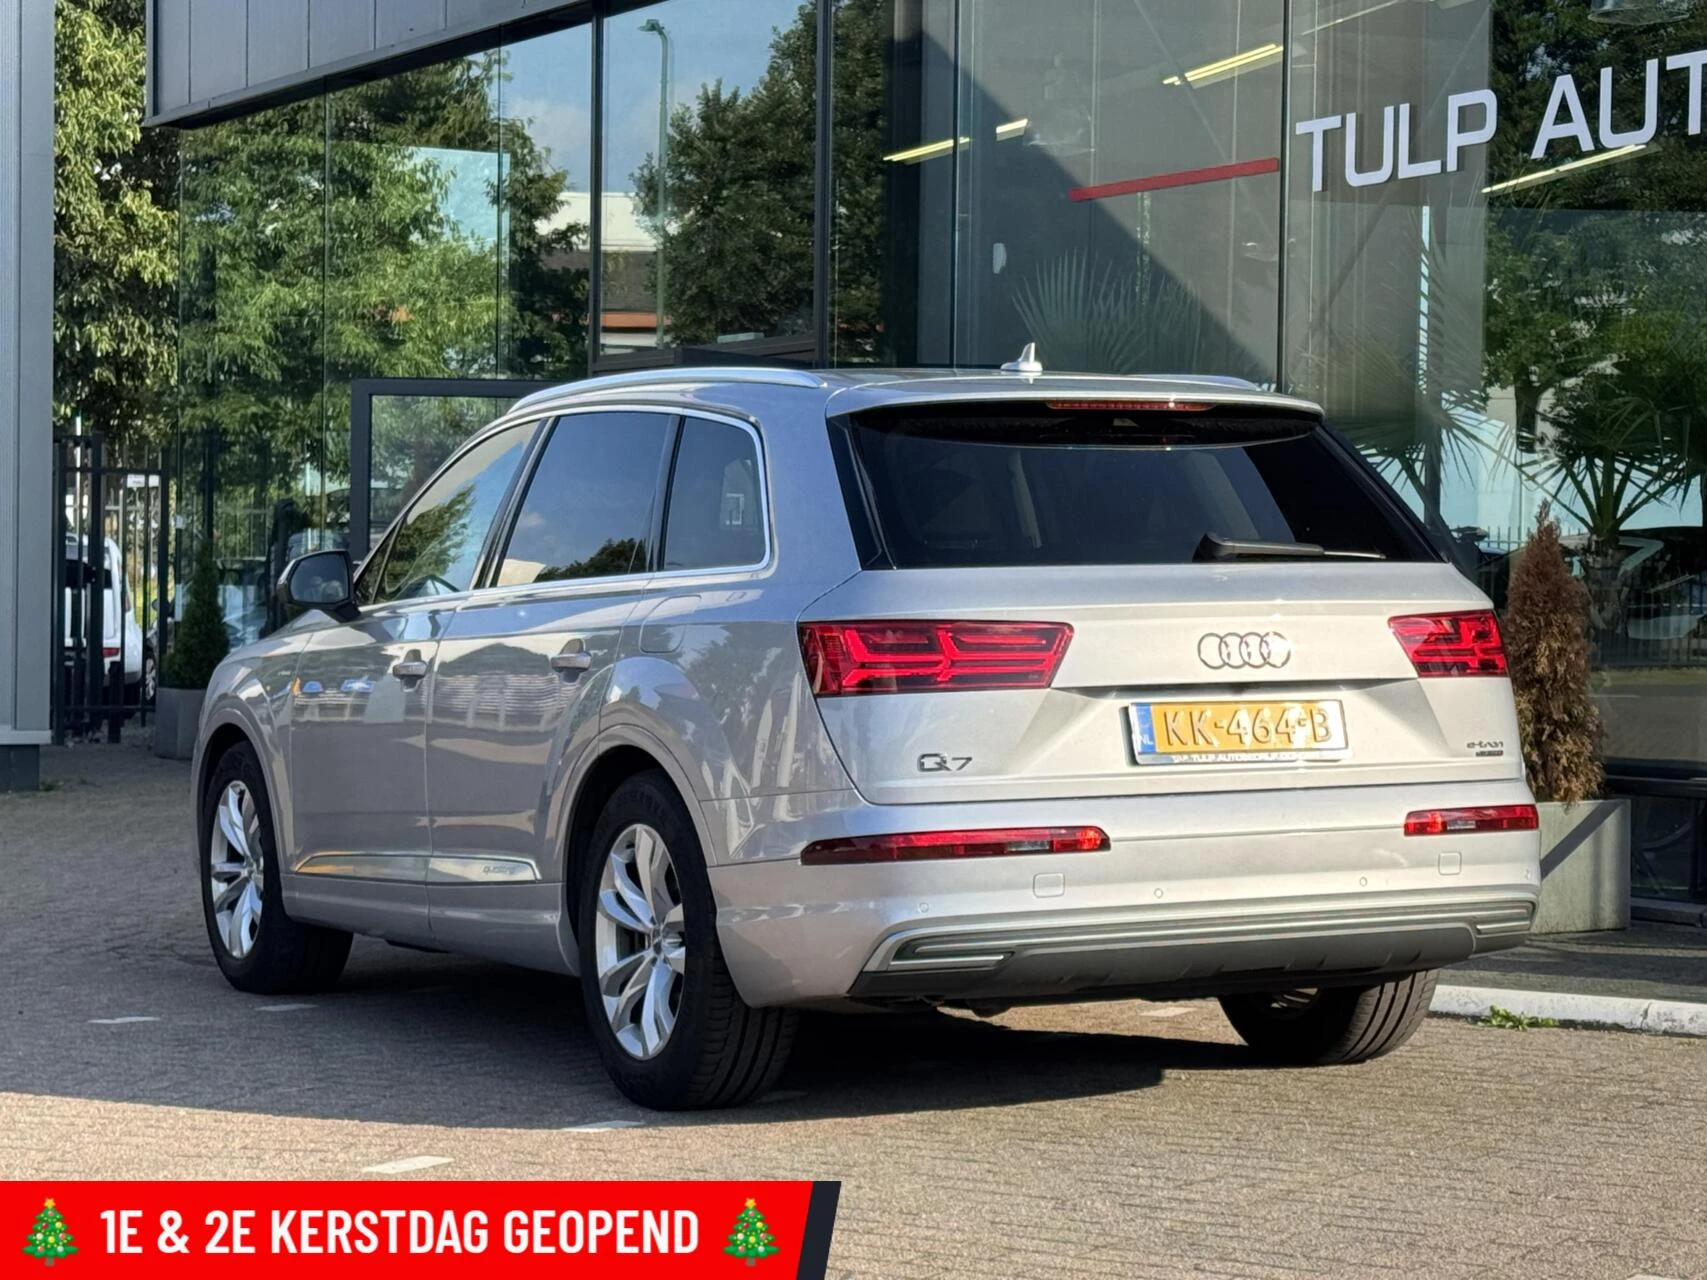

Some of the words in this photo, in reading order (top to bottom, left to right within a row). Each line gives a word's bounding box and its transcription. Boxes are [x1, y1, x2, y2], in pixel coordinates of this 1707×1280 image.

[1296, 89, 1498, 192] TULP
[1531, 50, 1707, 159] AUT
[1163, 706, 1333, 746] KK-464-B
[917, 753, 973, 772] Q7
